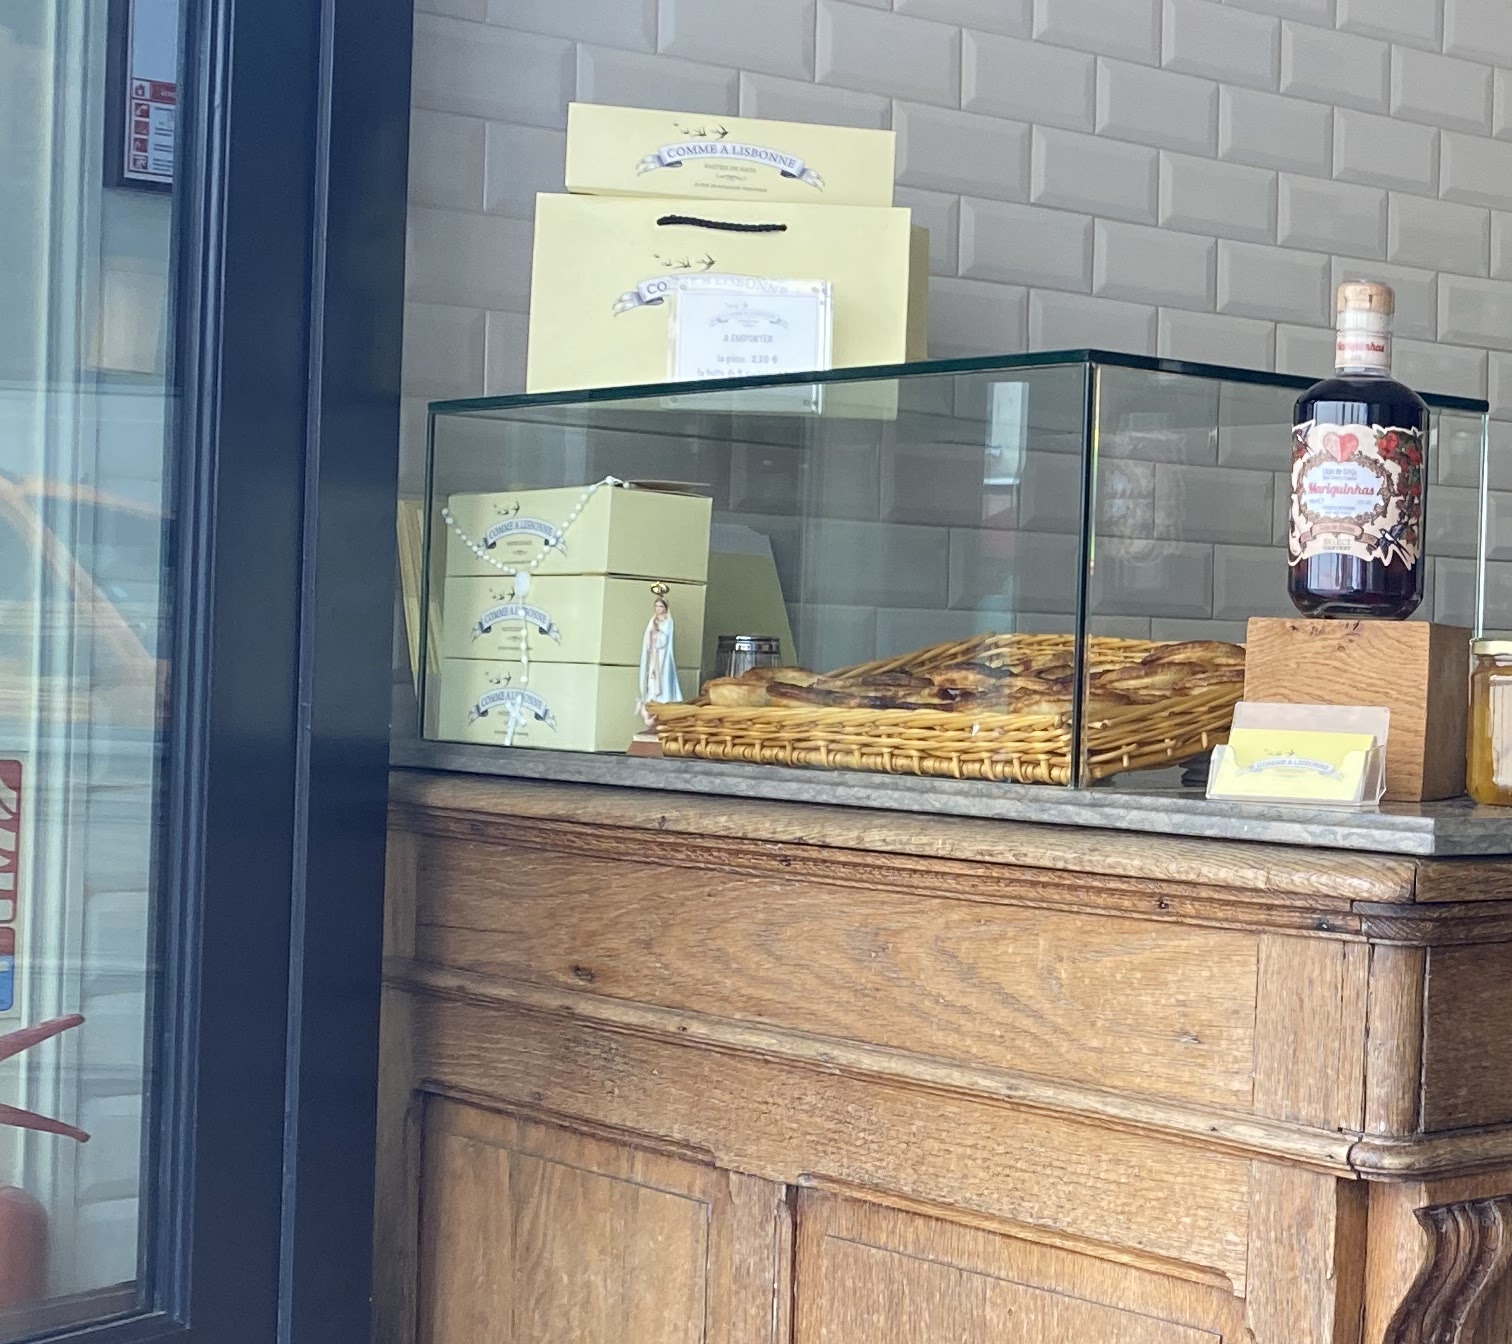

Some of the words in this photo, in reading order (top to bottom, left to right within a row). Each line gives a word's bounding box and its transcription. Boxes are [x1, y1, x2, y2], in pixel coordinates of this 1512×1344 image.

[666, 144, 718, 159] COMME
[720, 145, 729, 155] A
[731, 145, 797, 169] LISBONNE
[488, 520, 514, 540] COMME
[518, 519, 554, 537] LISBONNE
